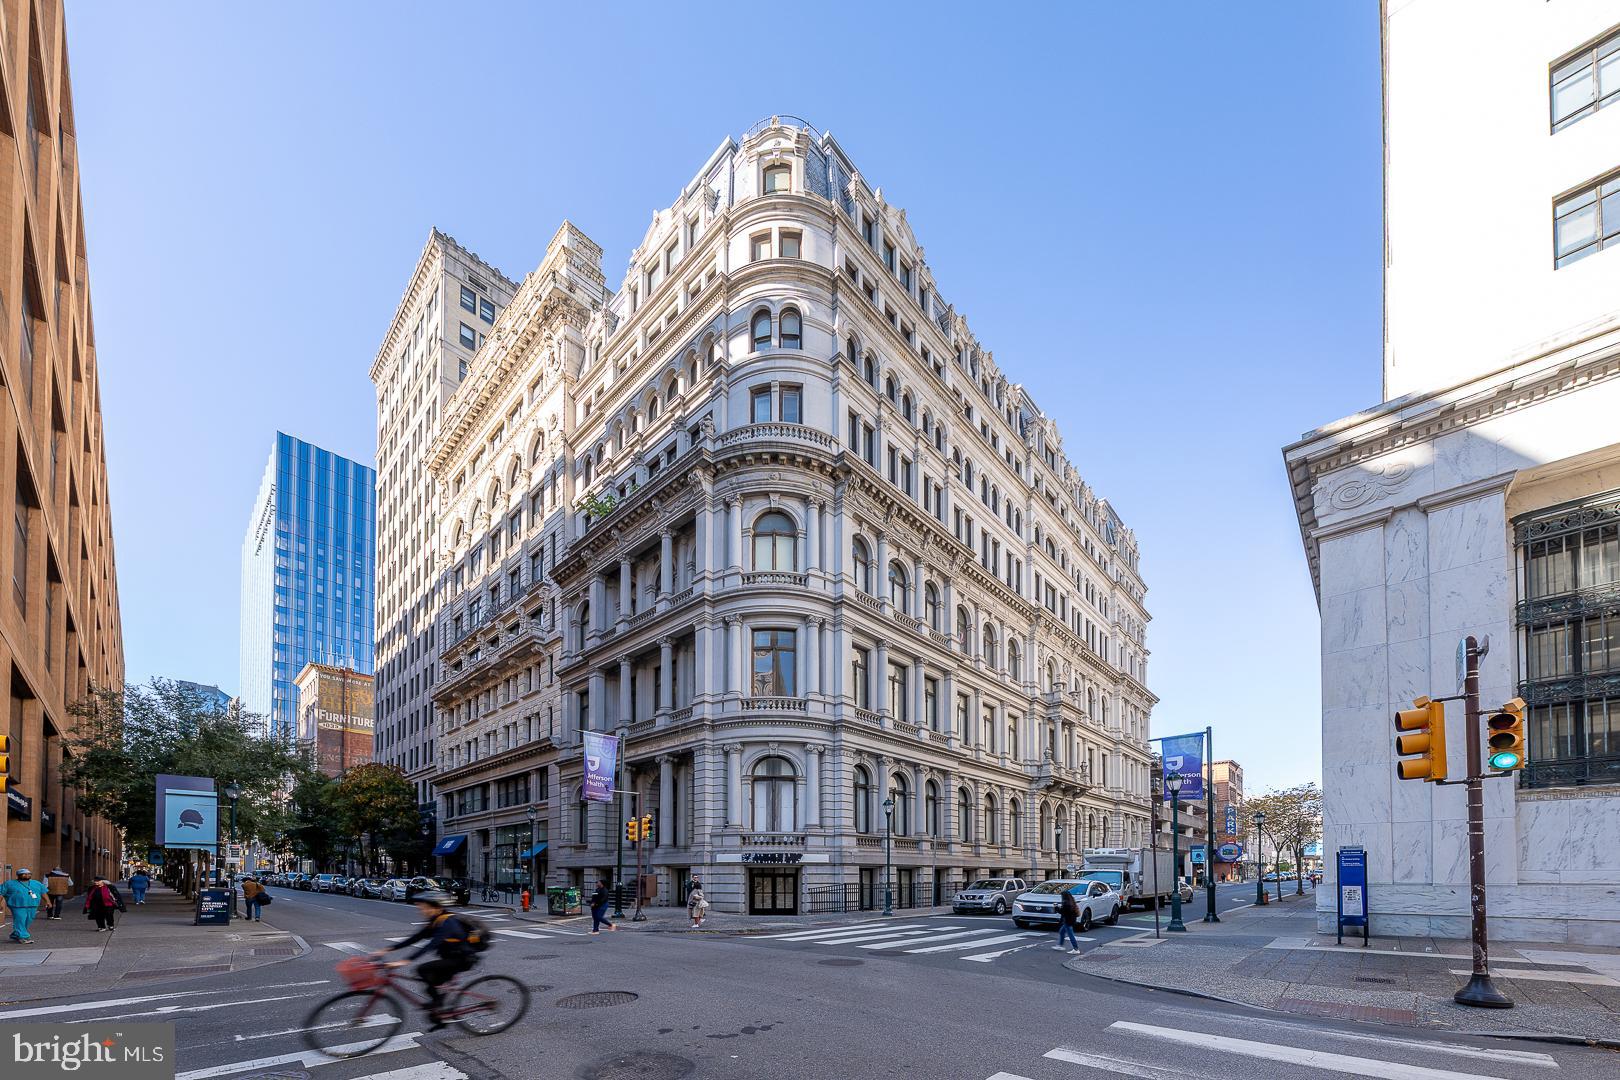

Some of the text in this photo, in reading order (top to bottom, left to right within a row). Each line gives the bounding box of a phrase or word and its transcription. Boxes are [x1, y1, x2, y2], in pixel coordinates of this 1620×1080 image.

[319, 709, 374, 728] FURNITURE
[587, 773, 612, 782] Jfferson
[587, 780, 605, 788] Halth
[1227, 807, 1235, 834] PARK
